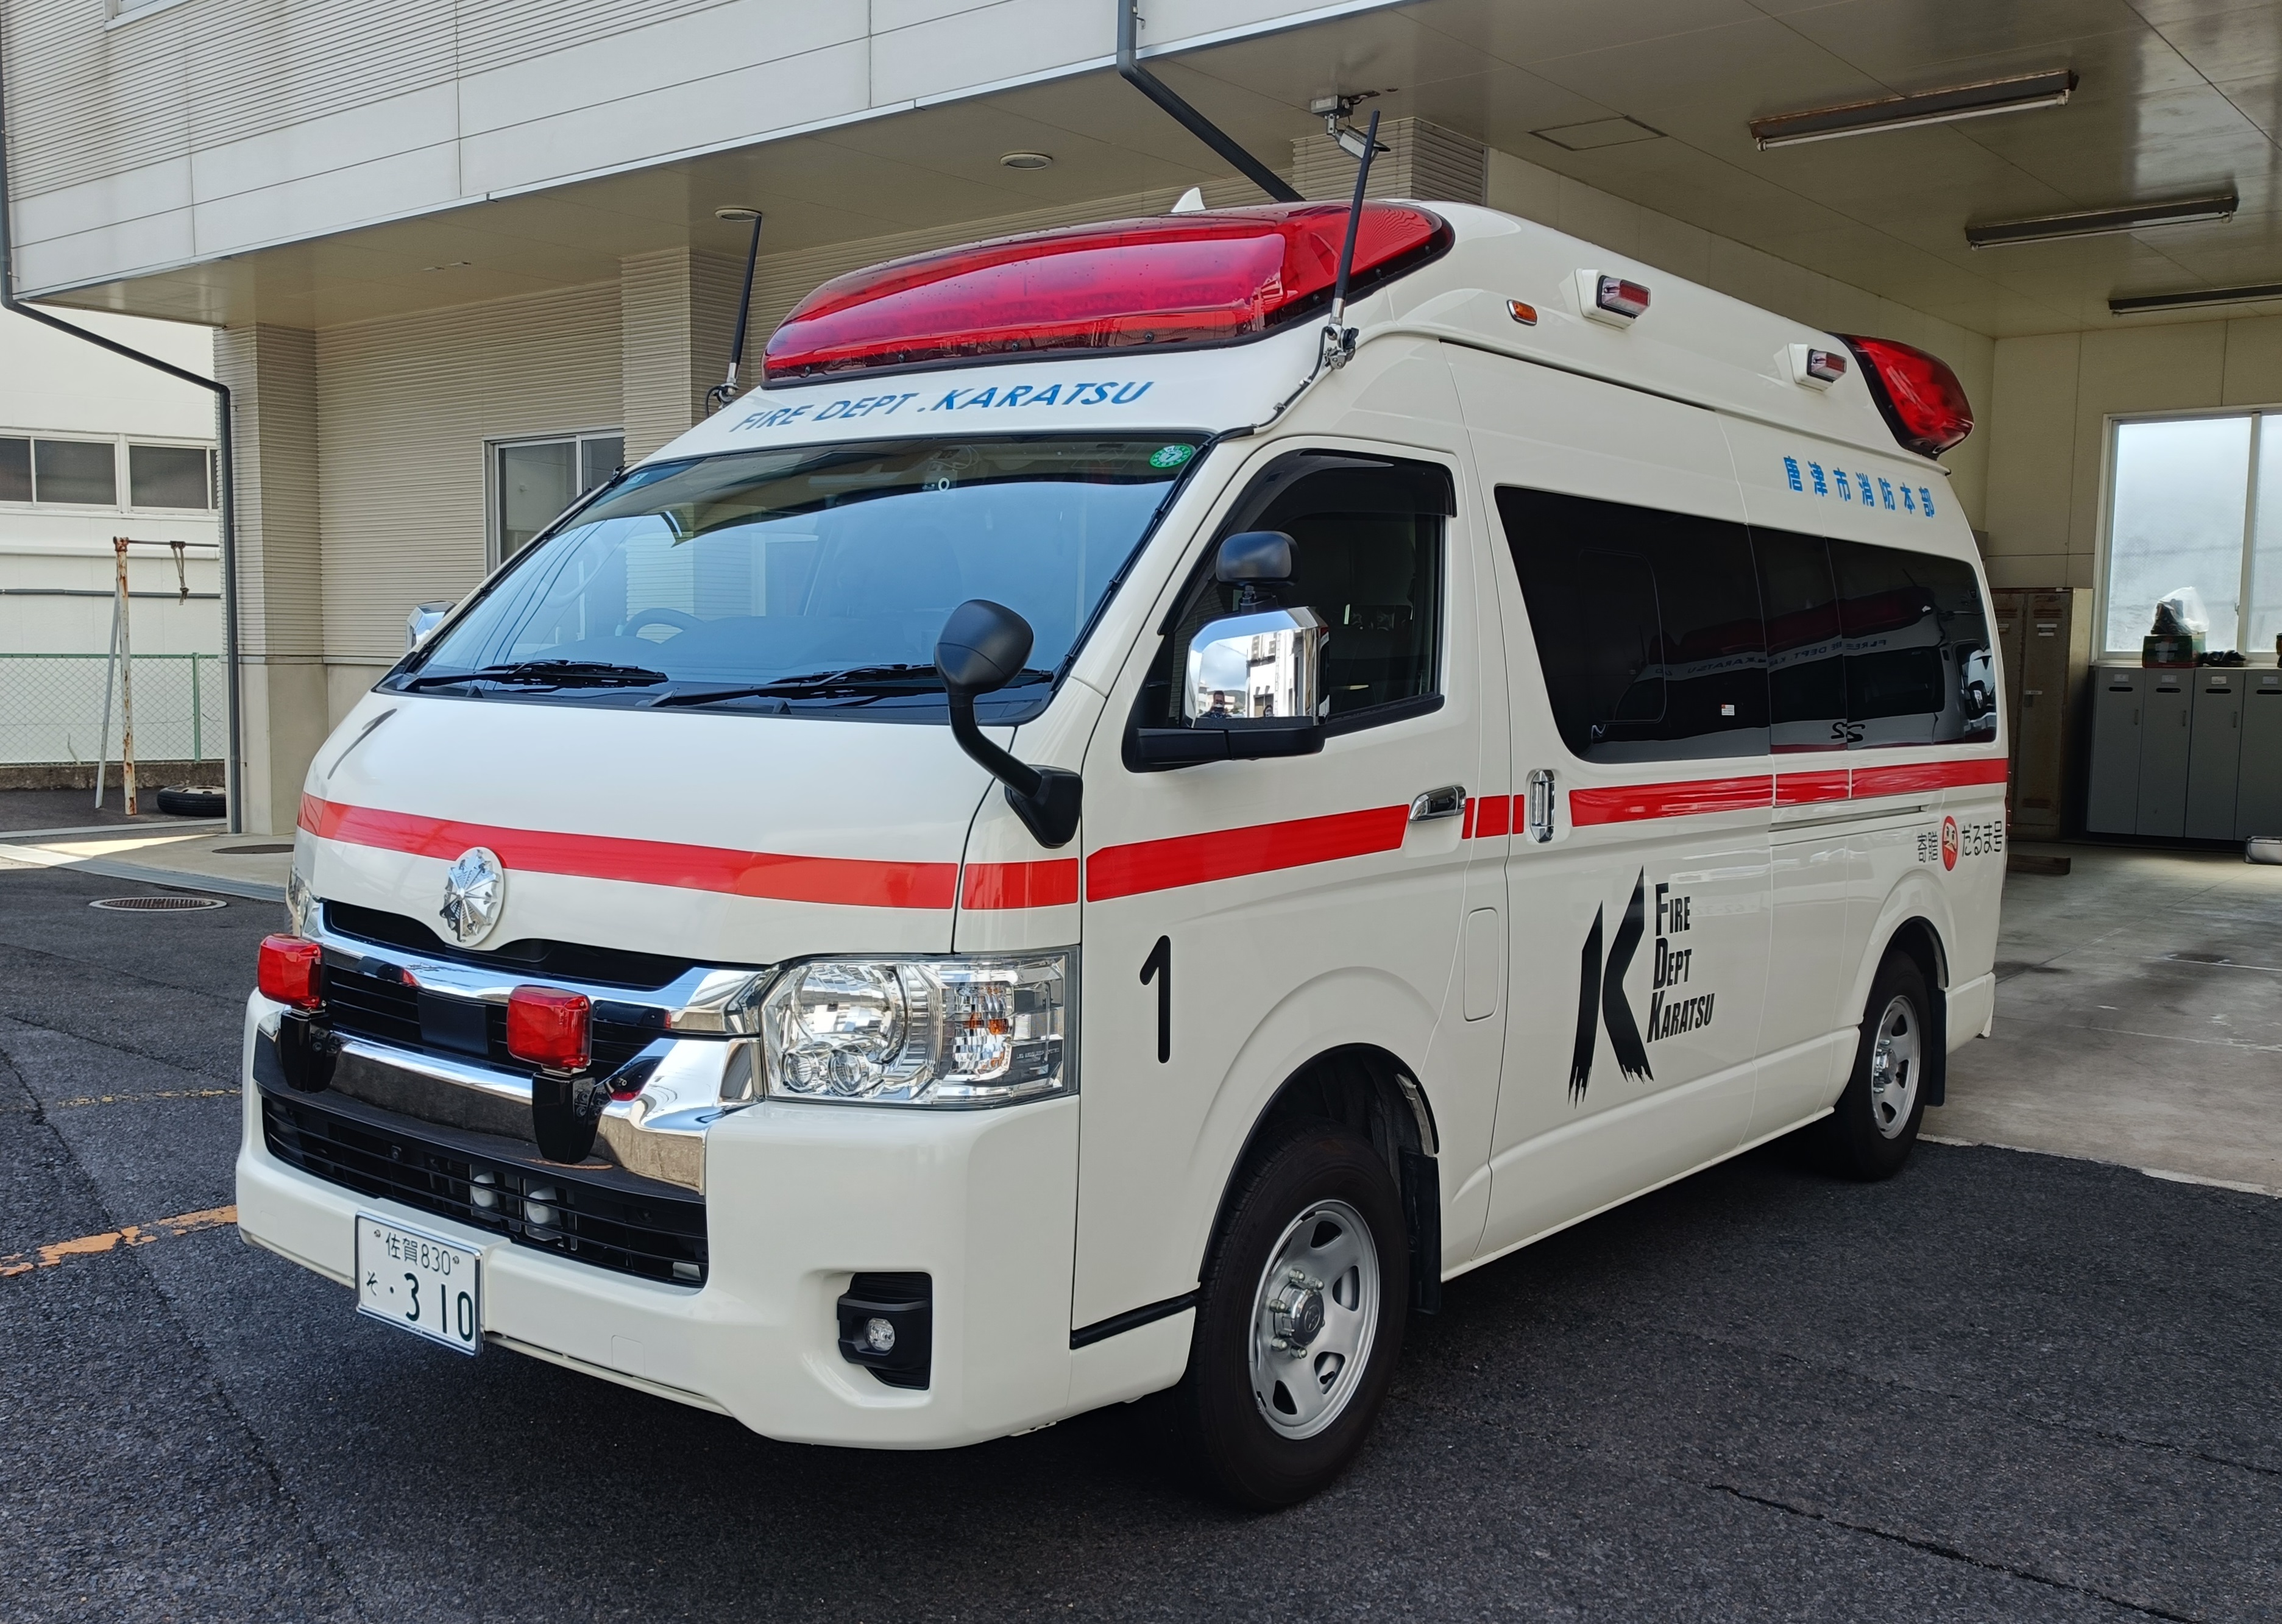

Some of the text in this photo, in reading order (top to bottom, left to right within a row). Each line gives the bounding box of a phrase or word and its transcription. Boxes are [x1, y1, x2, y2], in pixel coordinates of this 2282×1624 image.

[729, 404, 813, 433] FIRE
[1783, 455, 1935, 519] 唐津市消防本部
[1961, 820, 2003, 857] だるま号
[1655, 882, 1691, 937] FIRE
[1653, 937, 1692, 990] DEPT
[1139, 935, 1171, 1065] 1
[1646, 990, 1715, 1044] KARATSU
